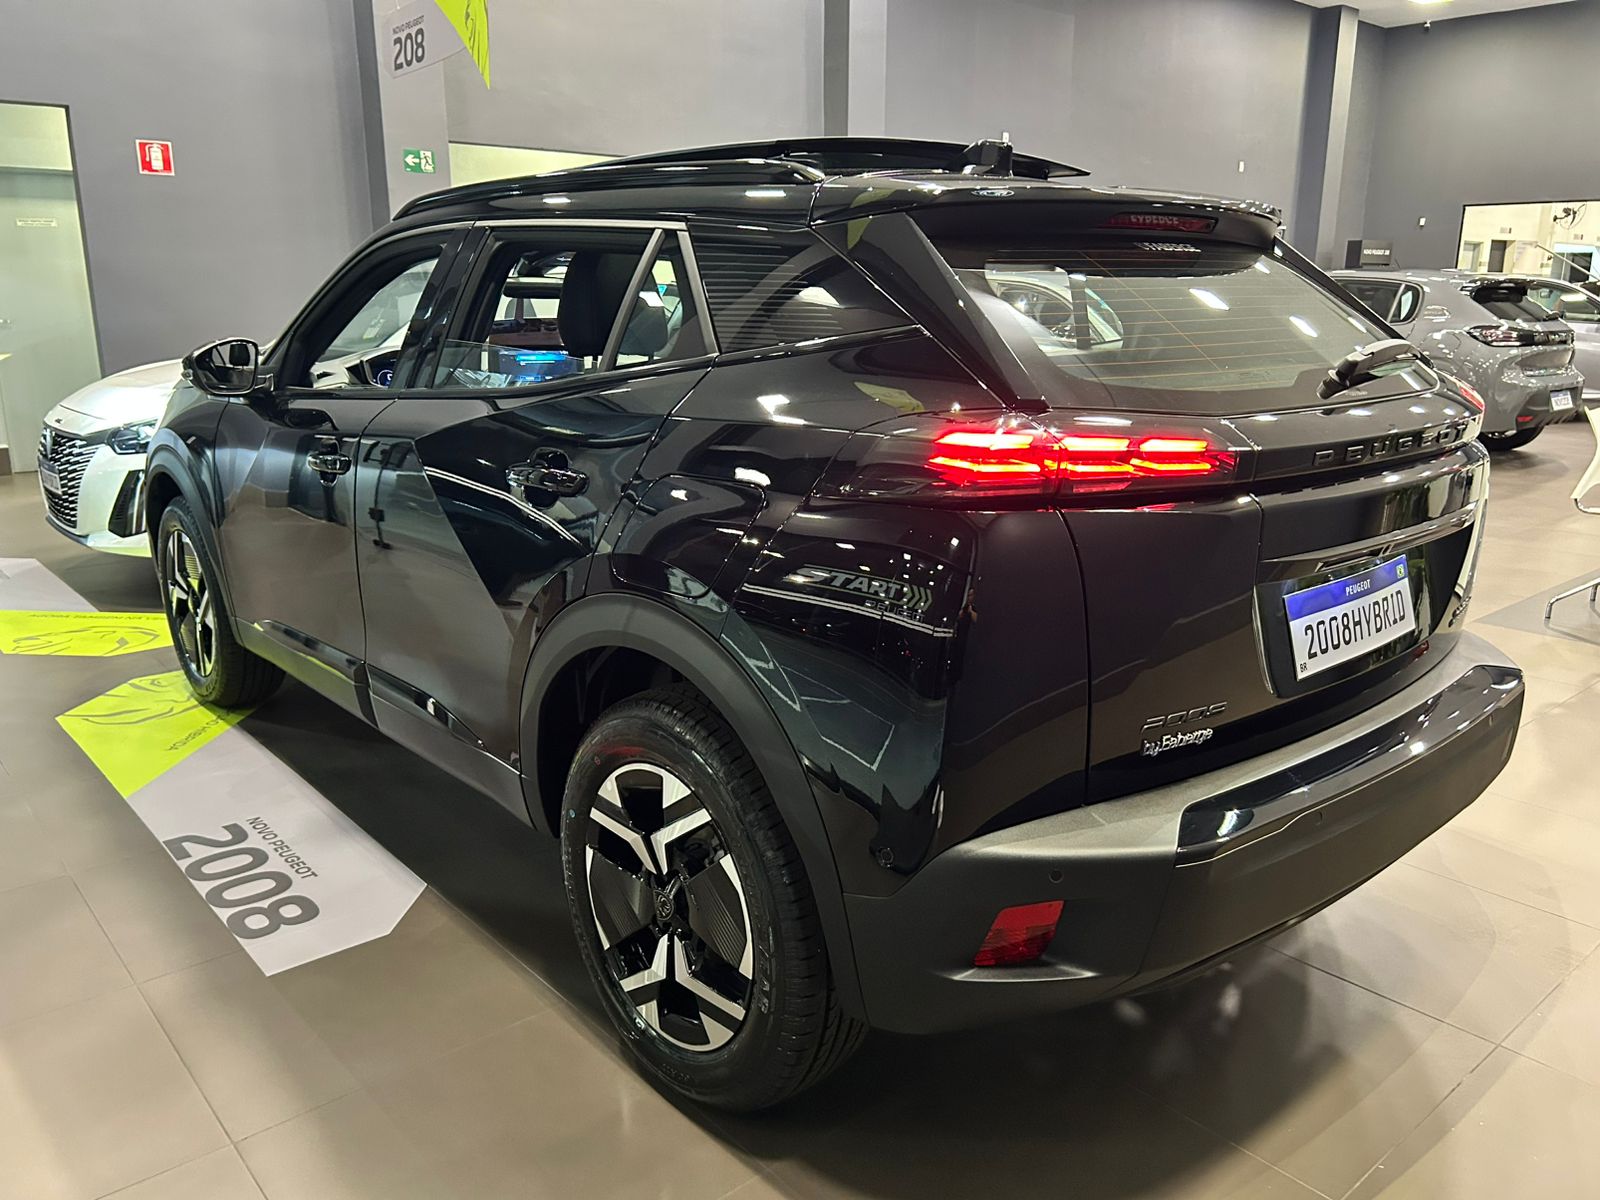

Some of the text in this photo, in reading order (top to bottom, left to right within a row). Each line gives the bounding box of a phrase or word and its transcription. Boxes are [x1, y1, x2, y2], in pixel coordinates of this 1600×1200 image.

[393, 27, 425, 71] 208
[1312, 424, 1468, 467] PEUGEOT
[1345, 579, 1371, 597] PEUGEOT
[1304, 590, 1406, 660] 2008HYBRID
[246, 816, 318, 879] NOVO PEUGEOT
[161, 822, 321, 940] 2008
